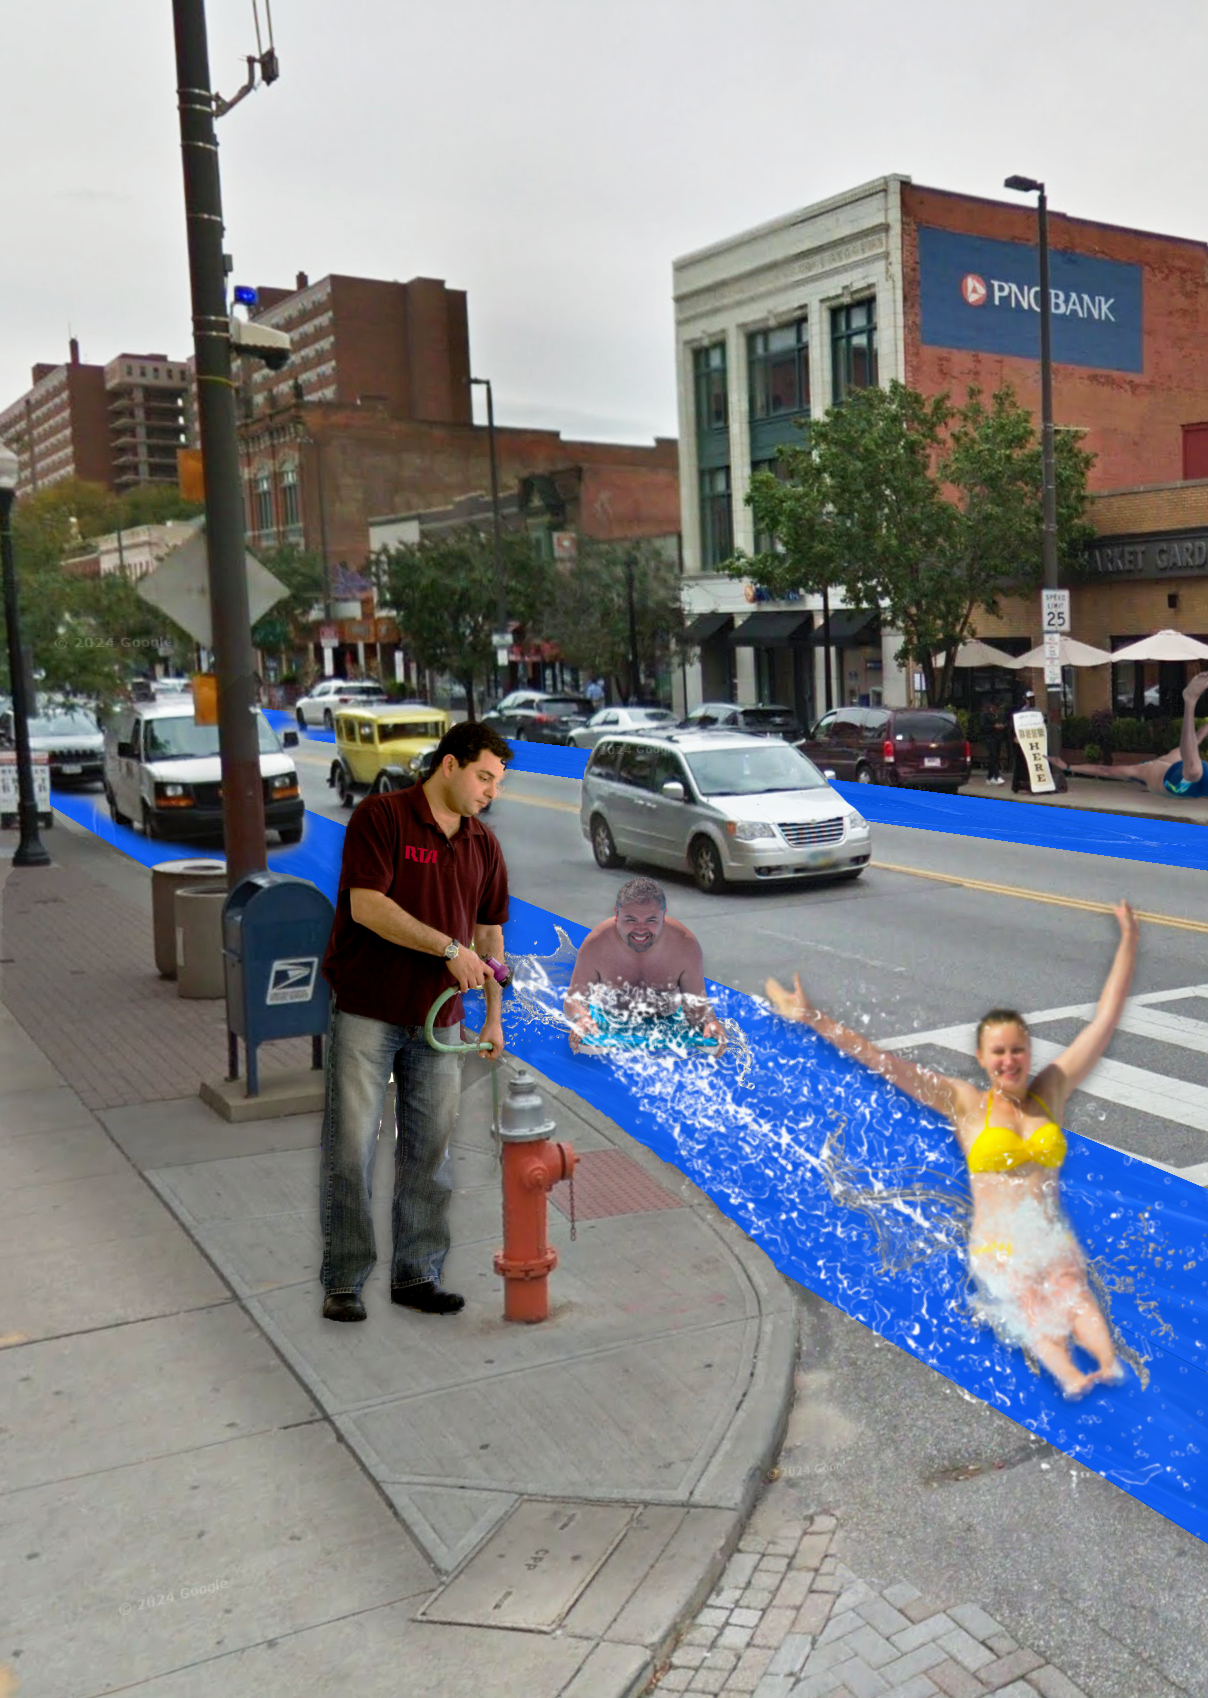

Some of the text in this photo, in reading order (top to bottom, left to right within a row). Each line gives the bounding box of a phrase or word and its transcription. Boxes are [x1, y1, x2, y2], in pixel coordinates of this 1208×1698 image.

[991, 280, 1116, 322] PNC BANK
[1047, 612, 1066, 627] 25
[1029, 742, 1047, 783] HERE
[405, 845, 438, 864] RTA
